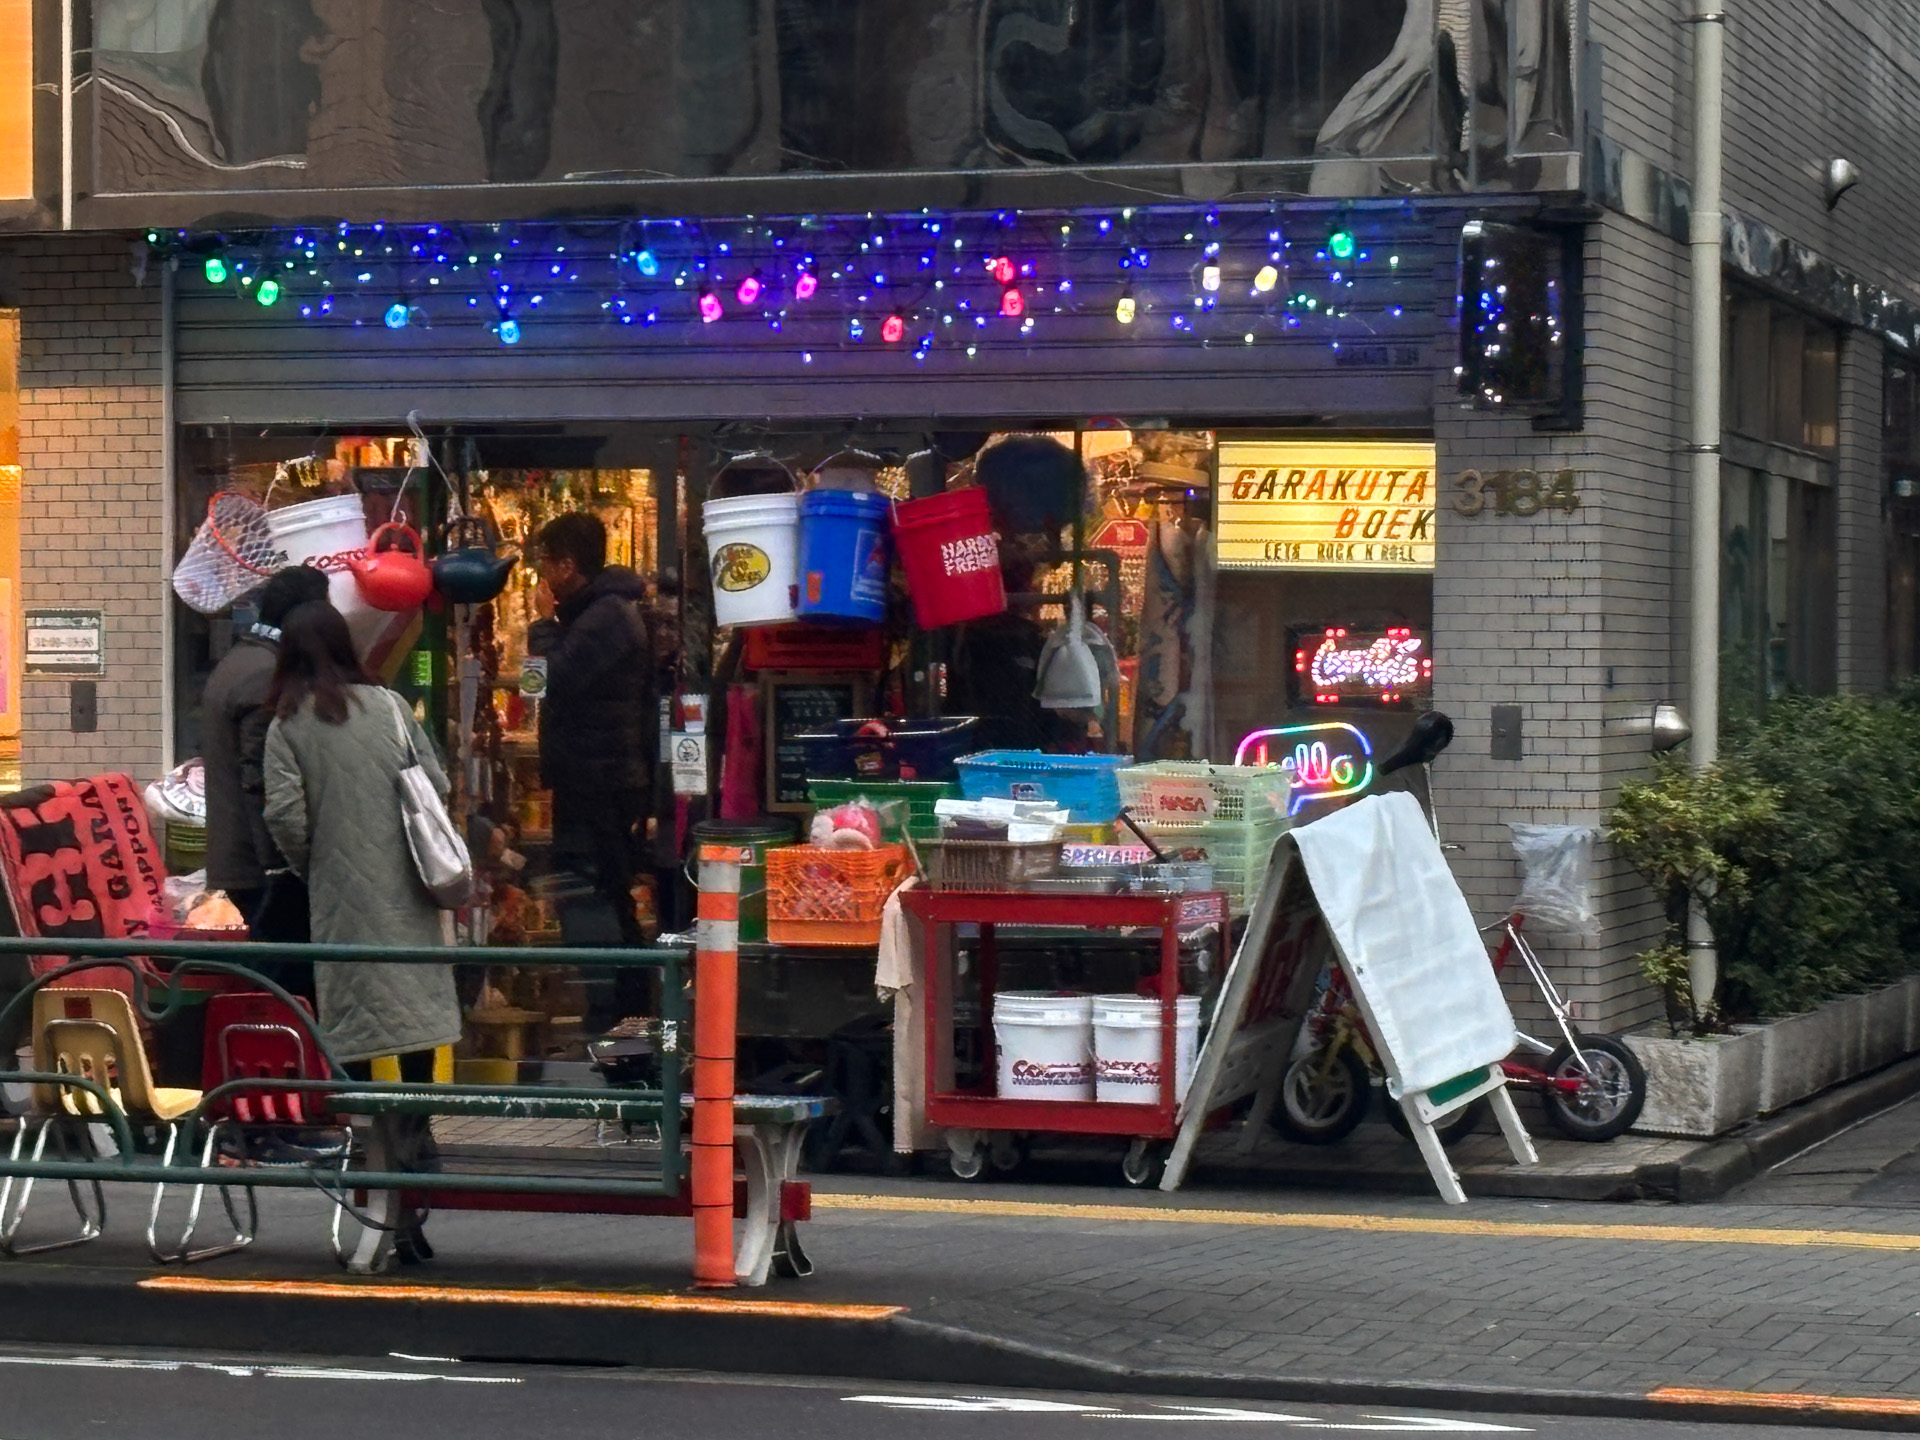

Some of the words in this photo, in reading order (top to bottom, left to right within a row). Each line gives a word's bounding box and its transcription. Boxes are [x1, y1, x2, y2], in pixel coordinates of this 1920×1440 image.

[1231, 469, 1430, 502] GARAKUTA
[1454, 468, 1581, 516] 3184
[1334, 507, 1435, 540] BOEK
[1160, 794, 1207, 812] NASA
